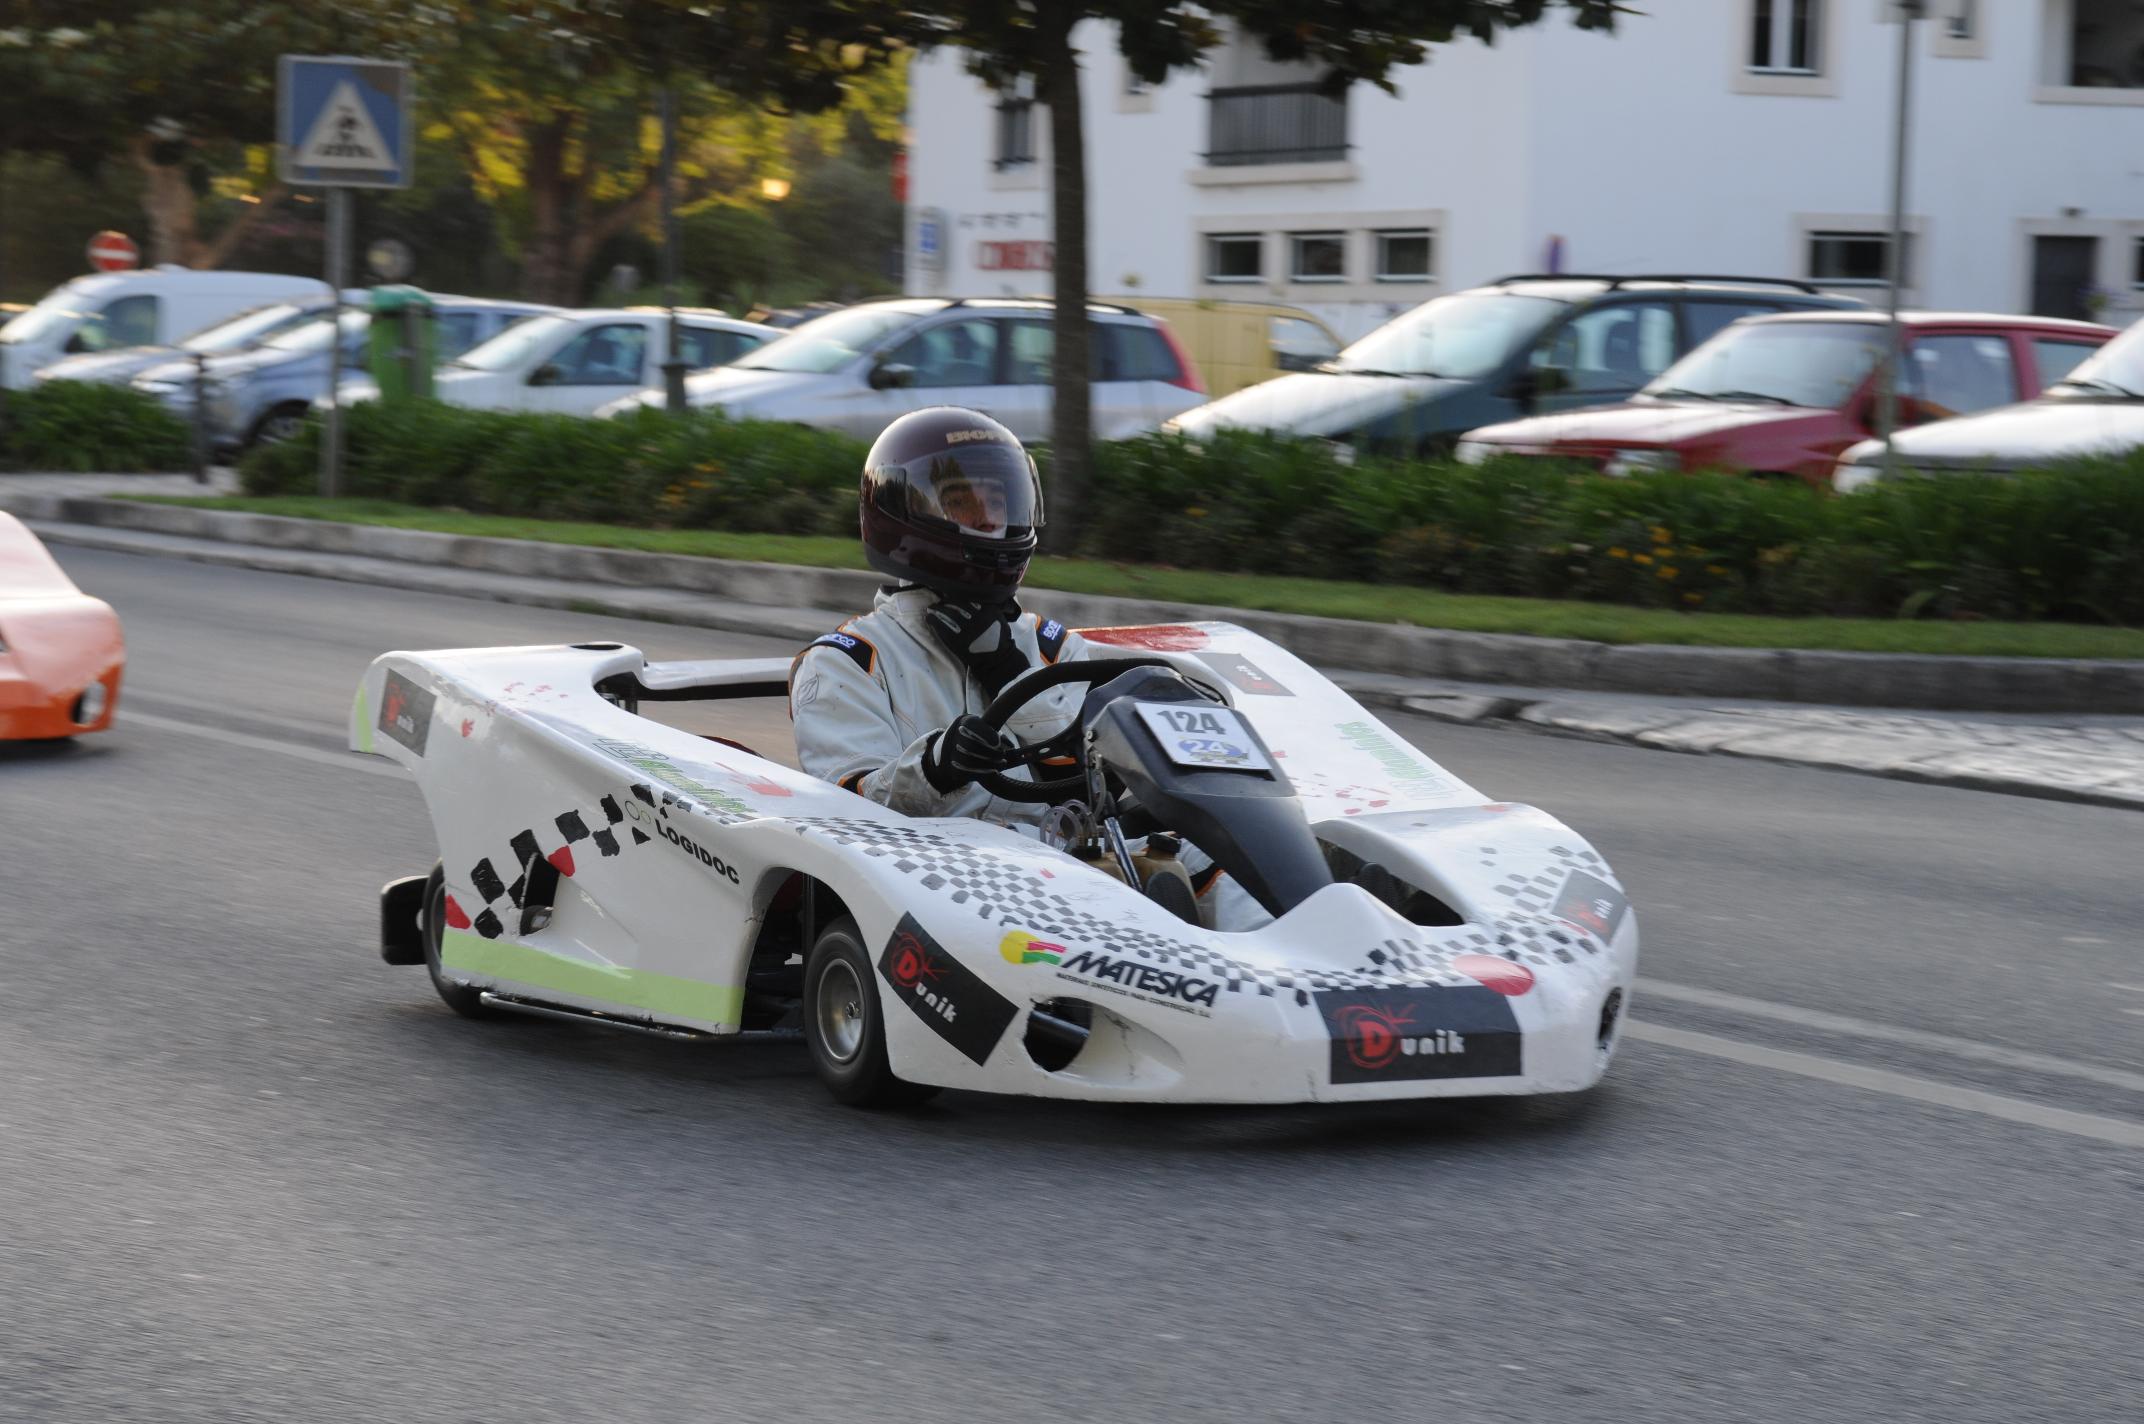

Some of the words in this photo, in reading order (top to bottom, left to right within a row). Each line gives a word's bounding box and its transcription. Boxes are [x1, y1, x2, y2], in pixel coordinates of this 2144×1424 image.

[1157, 710, 1226, 735] 124
[655, 818, 740, 885] LOGIDOC
[1061, 950, 1220, 1007] MATESICA
